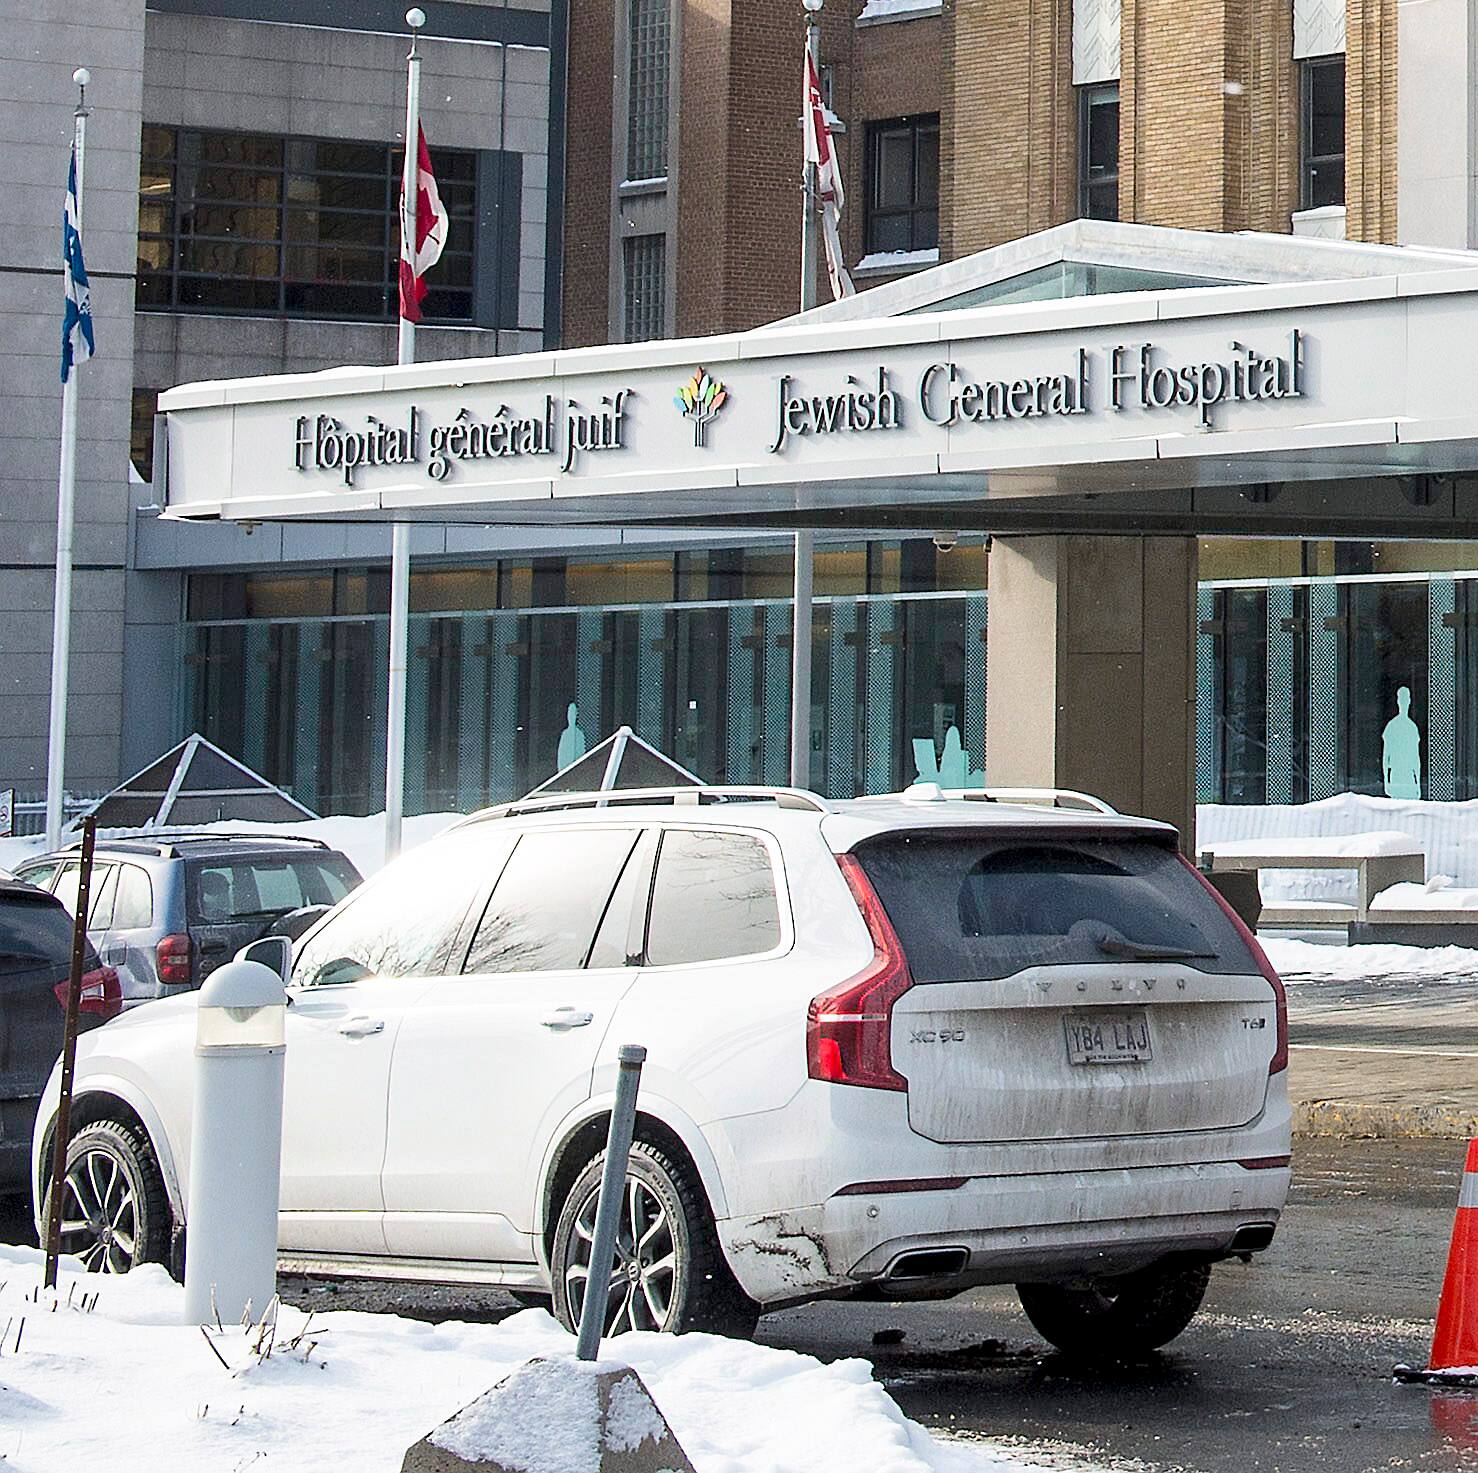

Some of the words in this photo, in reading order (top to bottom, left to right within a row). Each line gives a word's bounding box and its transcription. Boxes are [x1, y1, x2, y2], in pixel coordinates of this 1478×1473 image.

[293, 405, 419, 486] Hôpital
[428, 394, 553, 482] général
[558, 388, 636, 474] juif
[768, 365, 900, 455] Jewish
[918, 347, 1090, 428] General
[1102, 328, 1305, 430] Hospital
